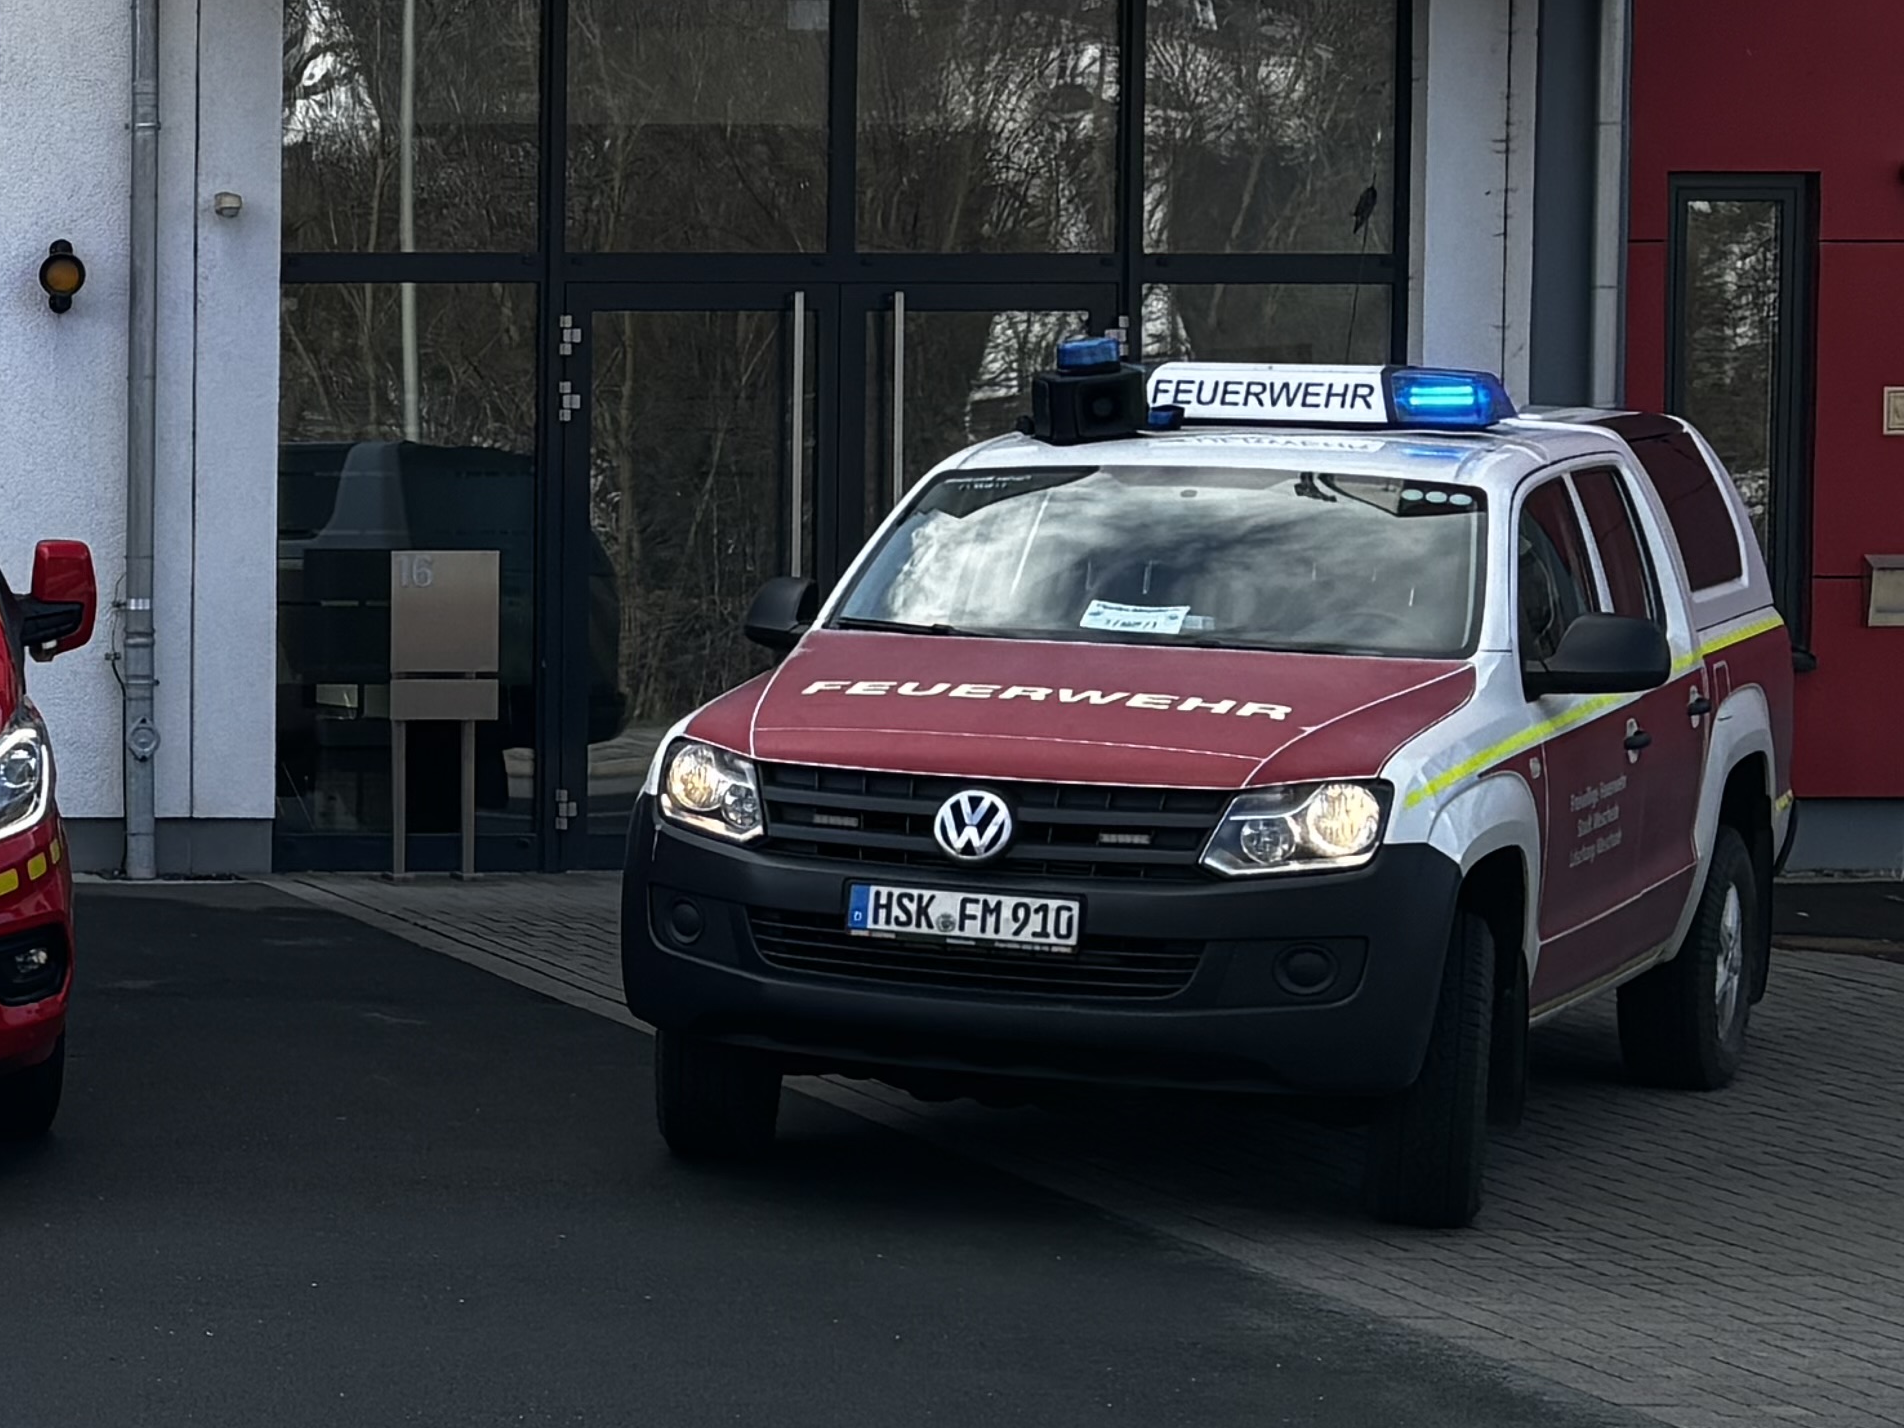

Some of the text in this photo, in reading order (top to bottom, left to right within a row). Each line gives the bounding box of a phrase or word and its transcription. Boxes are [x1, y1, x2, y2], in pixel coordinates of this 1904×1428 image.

[1151, 378, 1375, 410] FEUERWEHR
[396, 554, 433, 589] 16
[801, 680, 1293, 721] FEUERWEHR
[871, 889, 937, 930] HSK
[958, 896, 1003, 936] FM
[1011, 901, 1074, 940] 910
